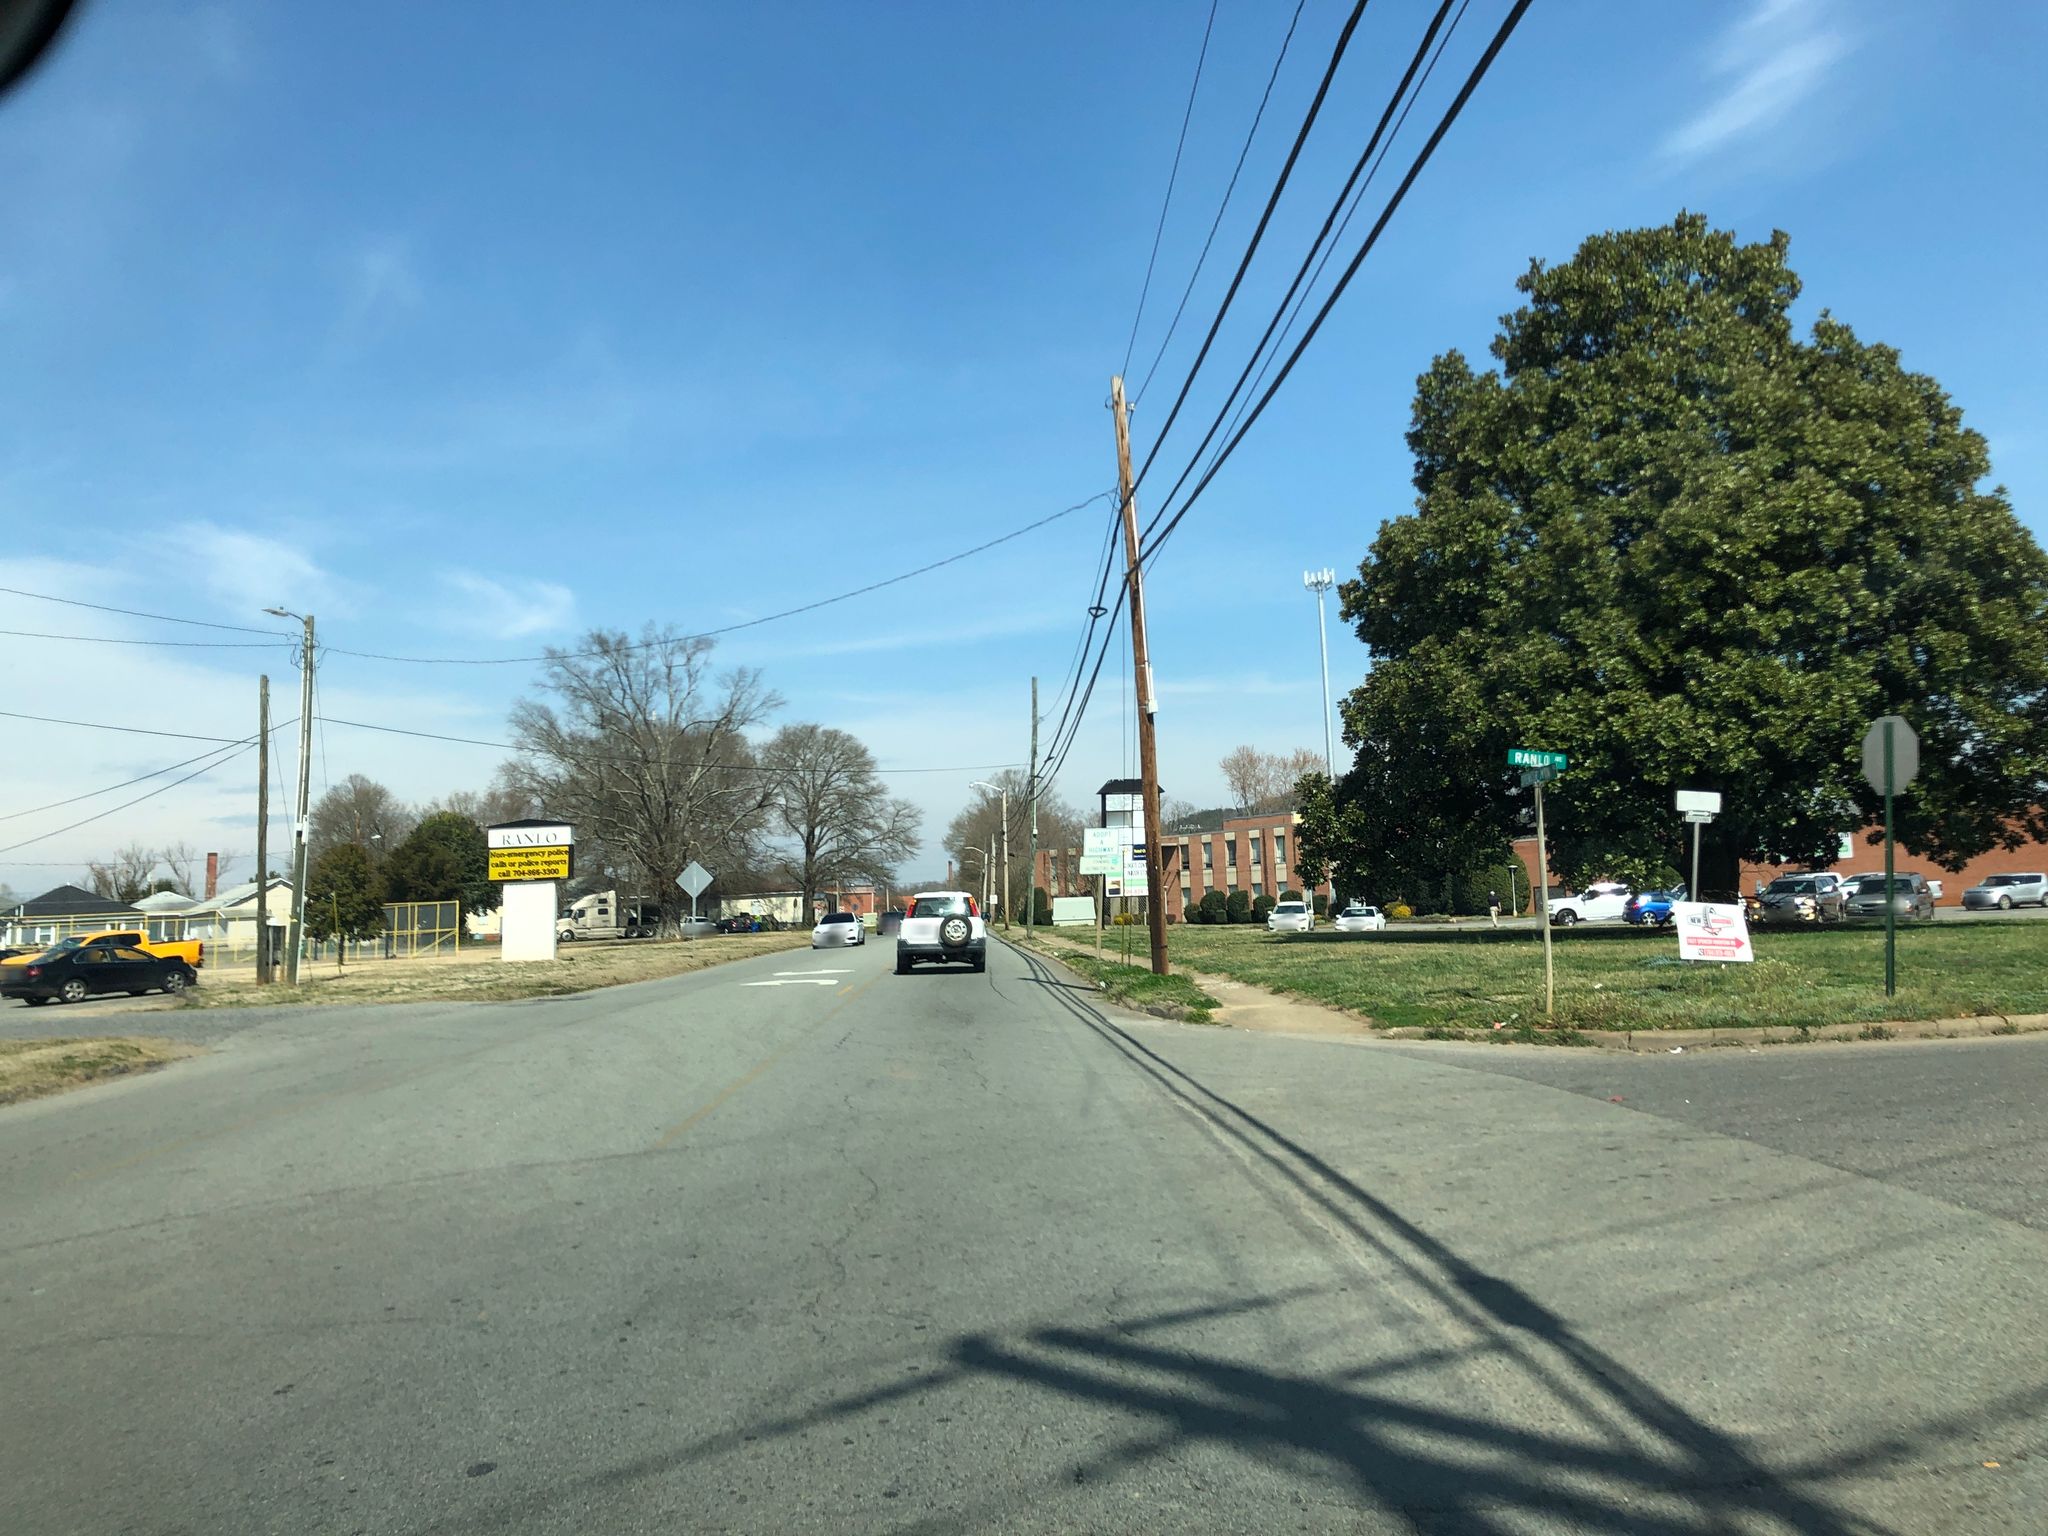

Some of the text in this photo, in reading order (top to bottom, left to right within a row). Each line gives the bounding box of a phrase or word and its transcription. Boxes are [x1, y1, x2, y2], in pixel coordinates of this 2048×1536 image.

[1515, 752, 1550, 766] RANLO
[490, 848, 569, 858] Non-emergency police
[491, 860, 507, 868] calls
[518, 860, 539, 869] police
[540, 859, 567, 867] reports
[498, 870, 511, 878] call
